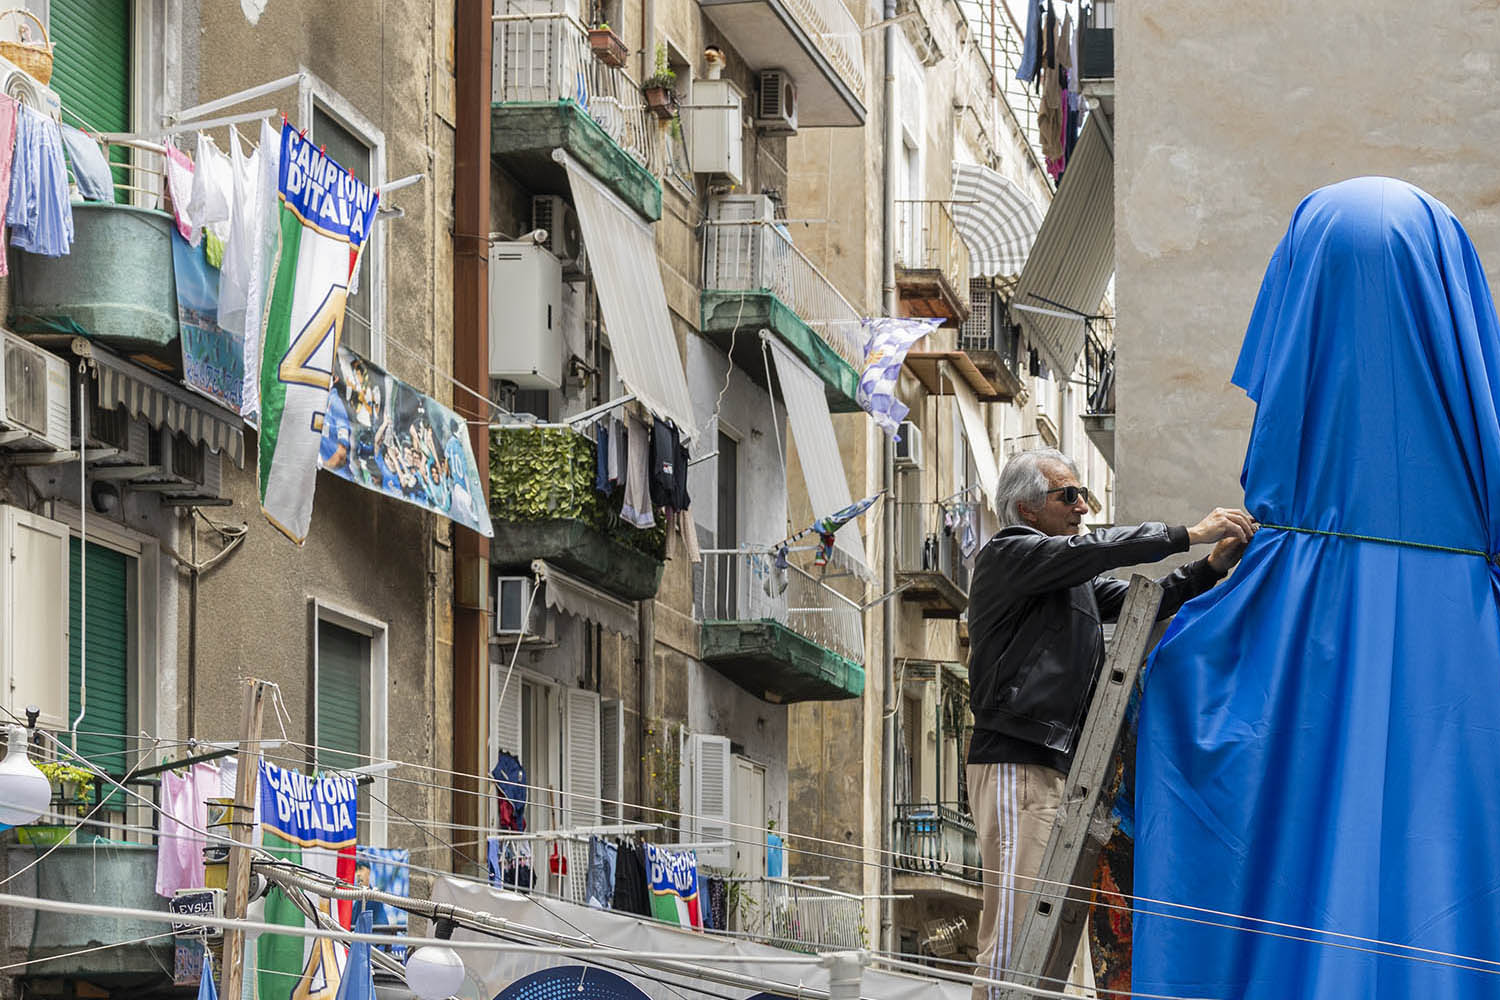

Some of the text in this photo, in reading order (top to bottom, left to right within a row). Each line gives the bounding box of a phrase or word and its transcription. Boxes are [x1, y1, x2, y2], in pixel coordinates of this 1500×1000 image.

[288, 130, 376, 213] CAMPIONI
[286, 162, 364, 238] D'ITALIA
[265, 763, 358, 806] CAMPIONI
[276, 791, 352, 832] D'ITALIA
[652, 863, 693, 890] D'ALIA
